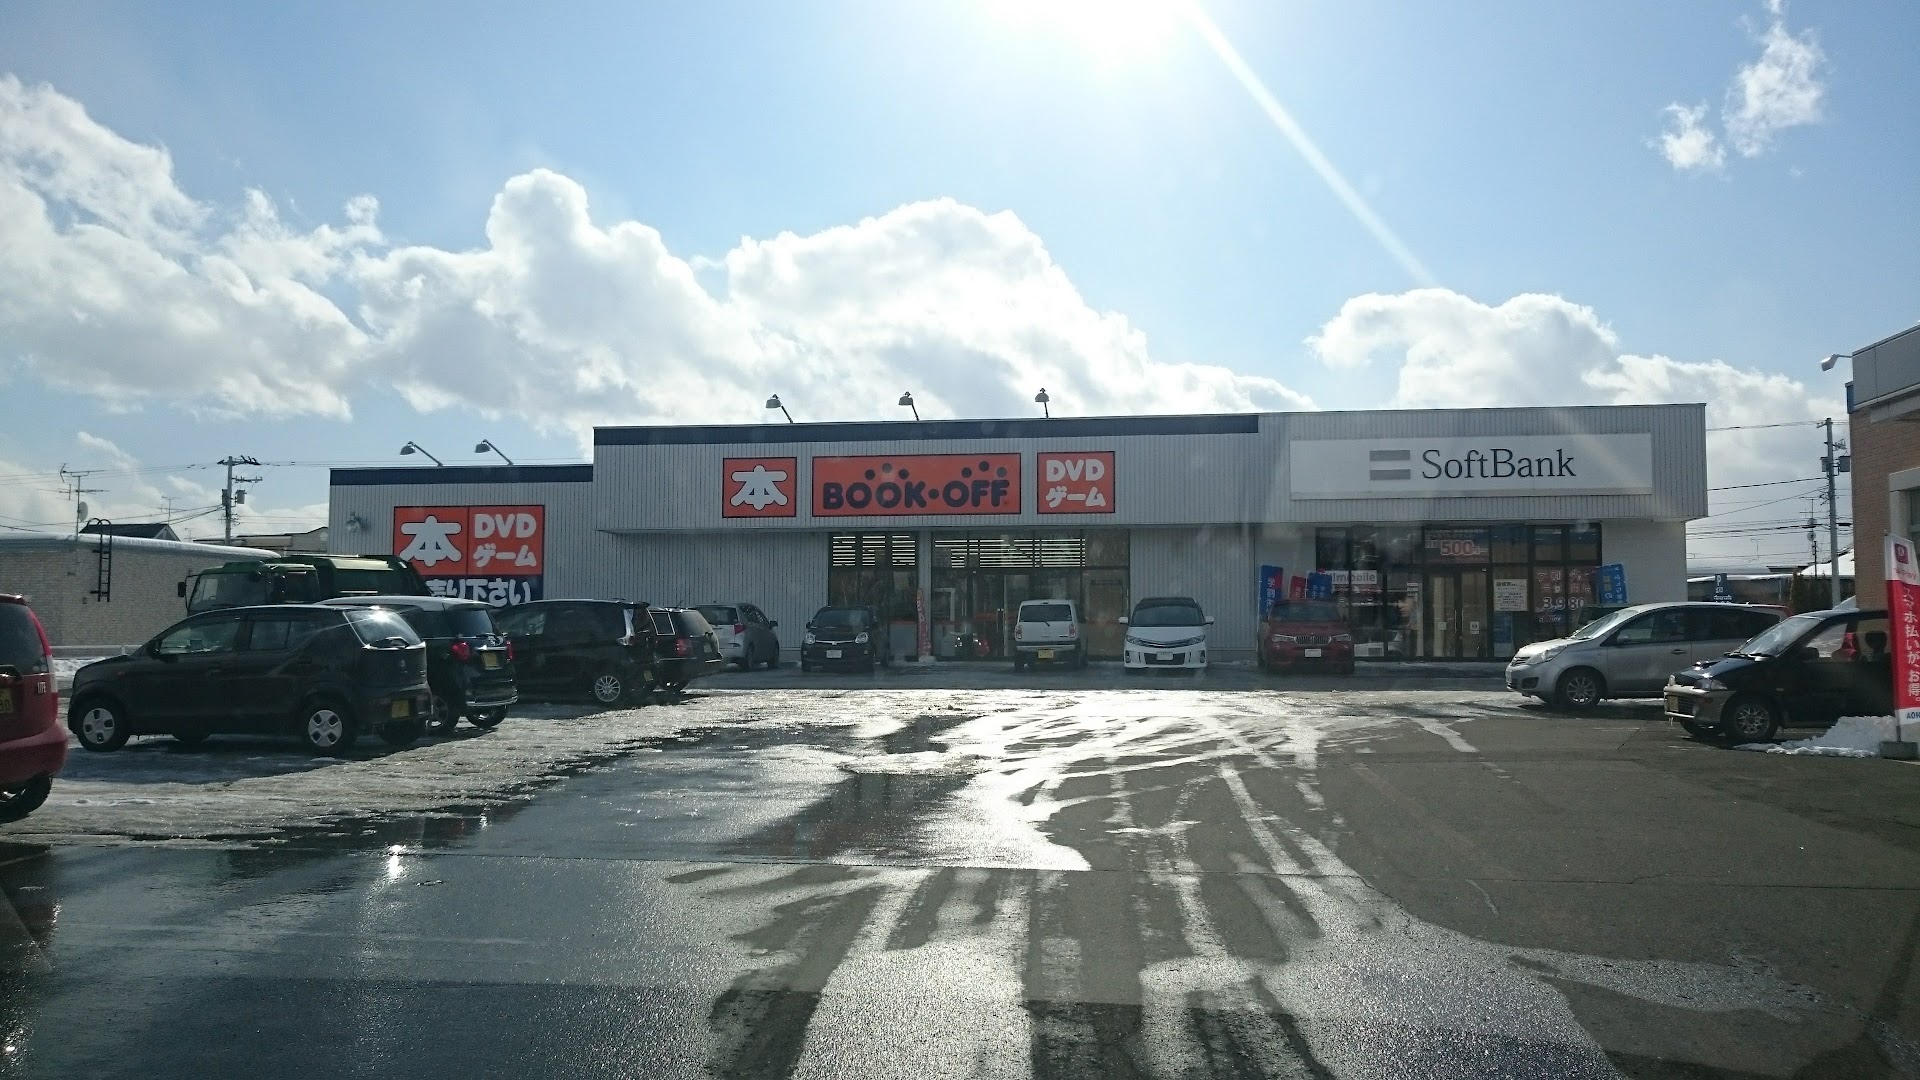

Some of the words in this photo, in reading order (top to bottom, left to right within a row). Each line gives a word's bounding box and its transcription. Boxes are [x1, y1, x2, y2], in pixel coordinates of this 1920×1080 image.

[1046, 459, 1105, 482] DVD
[1422, 448, 1577, 479] SoftBank
[730, 464, 788, 511] 本
[1045, 486, 1106, 509] ゲーム
[474, 513, 537, 538] DVD
[400, 515, 462, 567] 本
[473, 543, 537, 568] ゲーム
[1330, 572, 1376, 582] !mobile
